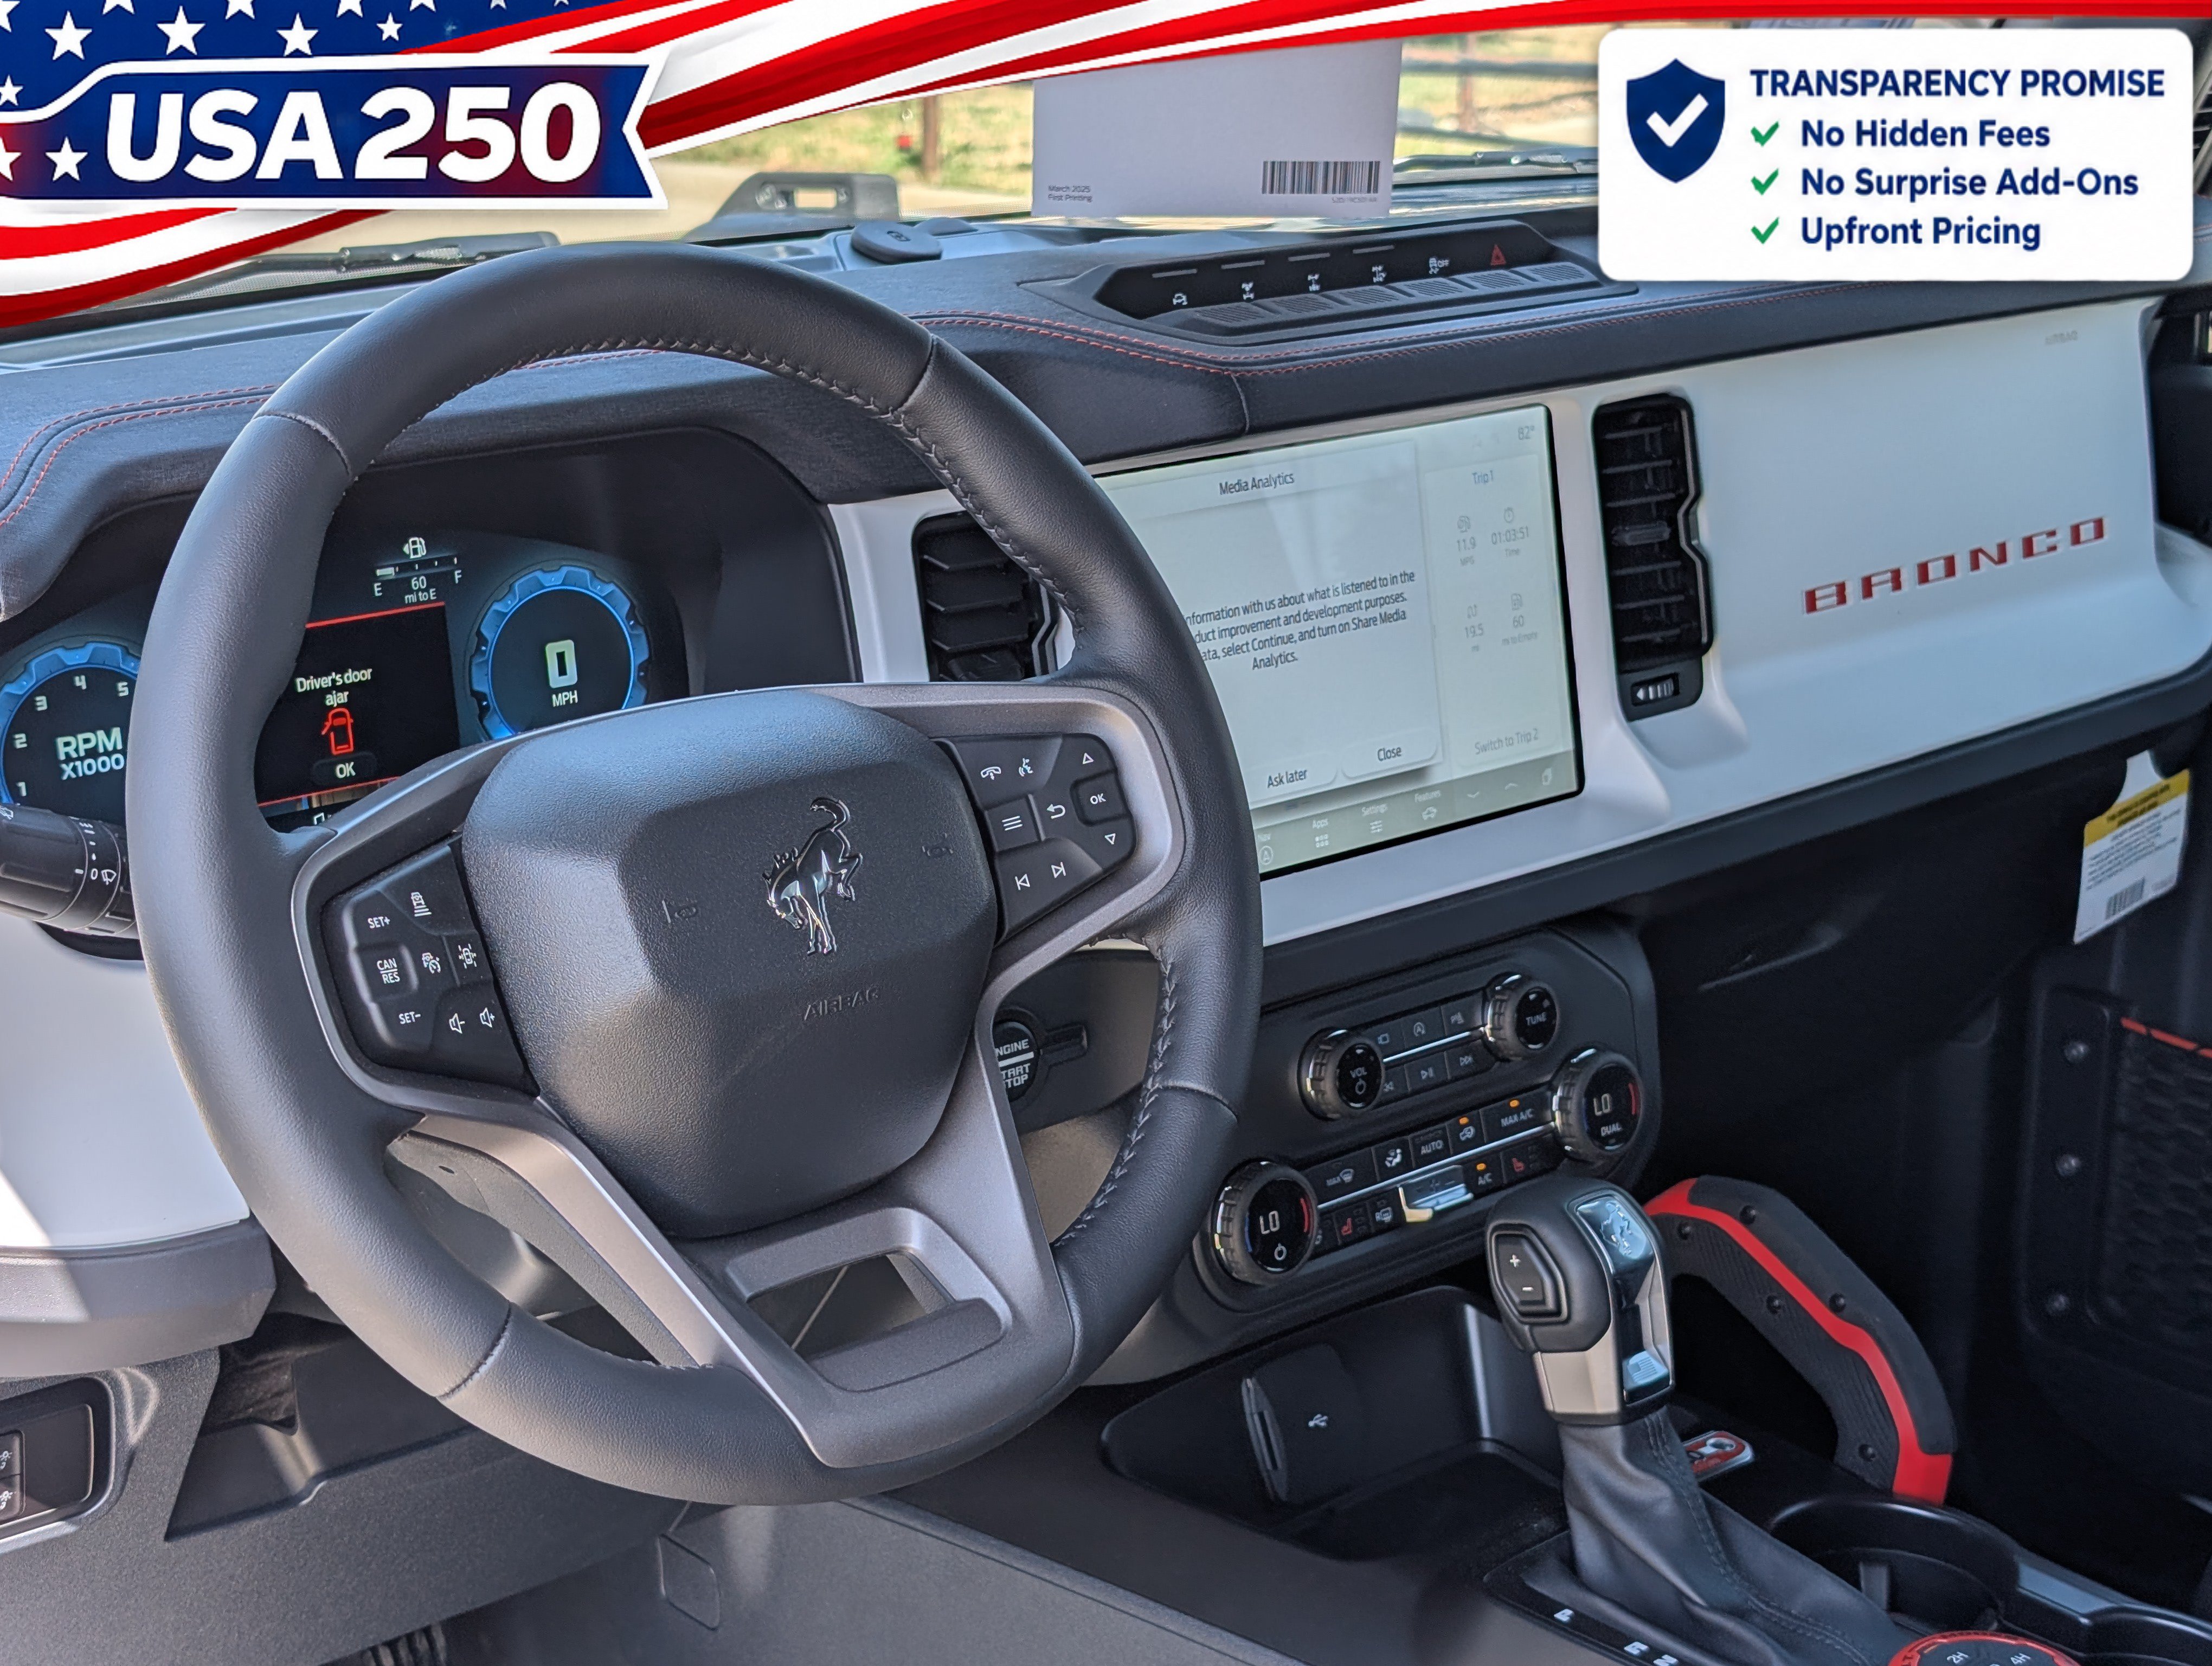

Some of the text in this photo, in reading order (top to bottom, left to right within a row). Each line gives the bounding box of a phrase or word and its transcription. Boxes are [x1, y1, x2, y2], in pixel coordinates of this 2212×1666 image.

[1065, 194, 1092, 203] Printing
[1219, 472, 1295, 496] Media Analytics
[1472, 471, 1489, 485] Trip
[1804, 516, 2105, 614] BRONCO
[411, 575, 427, 591] 60
[454, 569, 462, 584] F
[374, 582, 383, 597] E
[404, 588, 438, 605] mi to E
[1242, 599, 1264, 616] with
[1265, 599, 1276, 611] us
[1277, 592, 1306, 608] about
[1306, 586, 1331, 602] what
[1332, 585, 1340, 598] is
[1341, 576, 1377, 596] listened
[1379, 575, 1389, 588] to
[1390, 573, 1398, 586] in
[1399, 571, 1416, 584] the
[1194, 591, 1407, 644] duct improvement and development purposes.
[1201, 608, 1407, 663] ata, select Continue, and turn on Share Media
[545, 639, 578, 689] 0
[1251, 651, 1298, 671] Analytics.
[73, 675, 87, 691] 4
[295, 666, 373, 694] Driver's door
[117, 681, 130, 697] 5
[35, 695, 48, 712] 3
[324, 689, 349, 707] ajar
[551, 690, 578, 707] MPH
[13, 733, 28, 750] 2
[55, 727, 123, 761] RPM
[1475, 728, 1539, 755] Switch to Trip 2
[1377, 745, 1403, 762] Close
[335, 761, 356, 780] OK
[1266, 768, 1308, 789] Ask later
[17, 781, 27, 797] 1
[1089, 792, 1107, 805] OK
[1312, 818, 1329, 830] Apps
[368, 915, 391, 929] SET+
[377, 958, 397, 970] CAN
[382, 972, 401, 984] RES
[1525, 1012, 1547, 1027] TUNE
[994, 1039, 1030, 1058] NGINE
[1001, 1063, 1031, 1080] TART
[1349, 1066, 1367, 1079] VOL
[1004, 1074, 1028, 1088] TOP
[1593, 1093, 1613, 1117] LO
[1501, 1108, 1534, 1128] MAX A/C
[1600, 1122, 1624, 1138] DUAL
[1420, 1139, 1445, 1156] AUTO
[1477, 1172, 1493, 1186] A/C
[1258, 1209, 1281, 1236] LO
[1554, 1607, 1575, 1624] P
[1946, 1651, 1970, 1665] 2H
[2010, 1652, 2031, 1665] 4H
